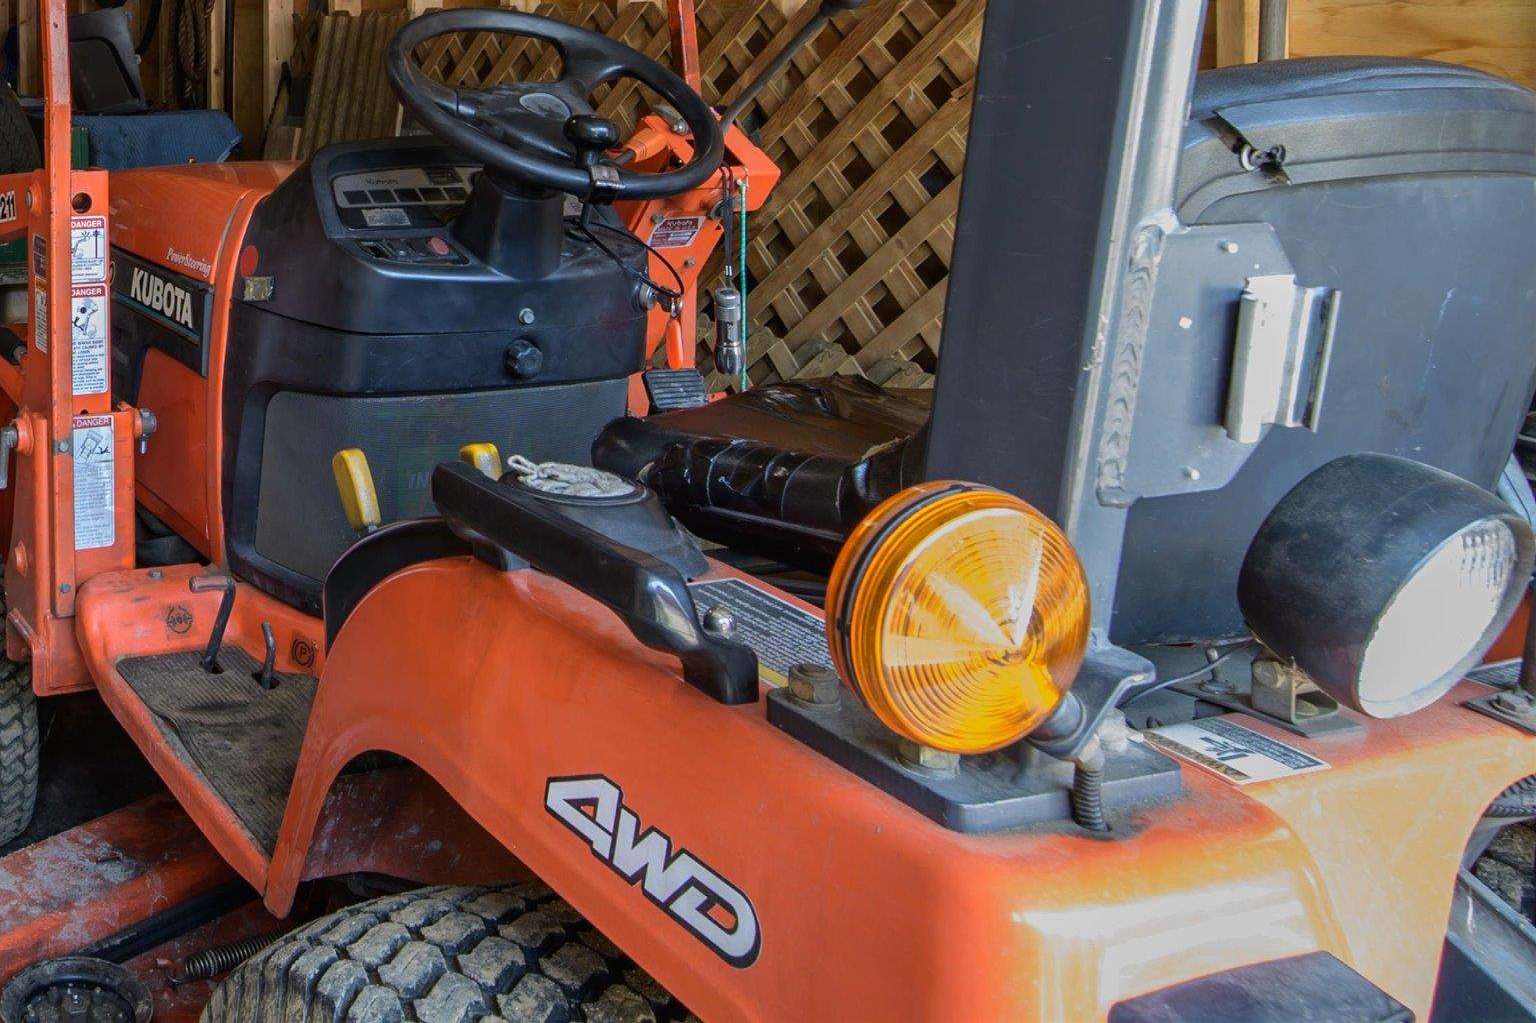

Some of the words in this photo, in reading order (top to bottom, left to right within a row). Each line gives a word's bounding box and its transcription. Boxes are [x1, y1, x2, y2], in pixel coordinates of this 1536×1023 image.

[71, 220, 102, 228] DANGER
[130, 267, 193, 329] KUBOTA
[76, 418, 110, 428] DANGER
